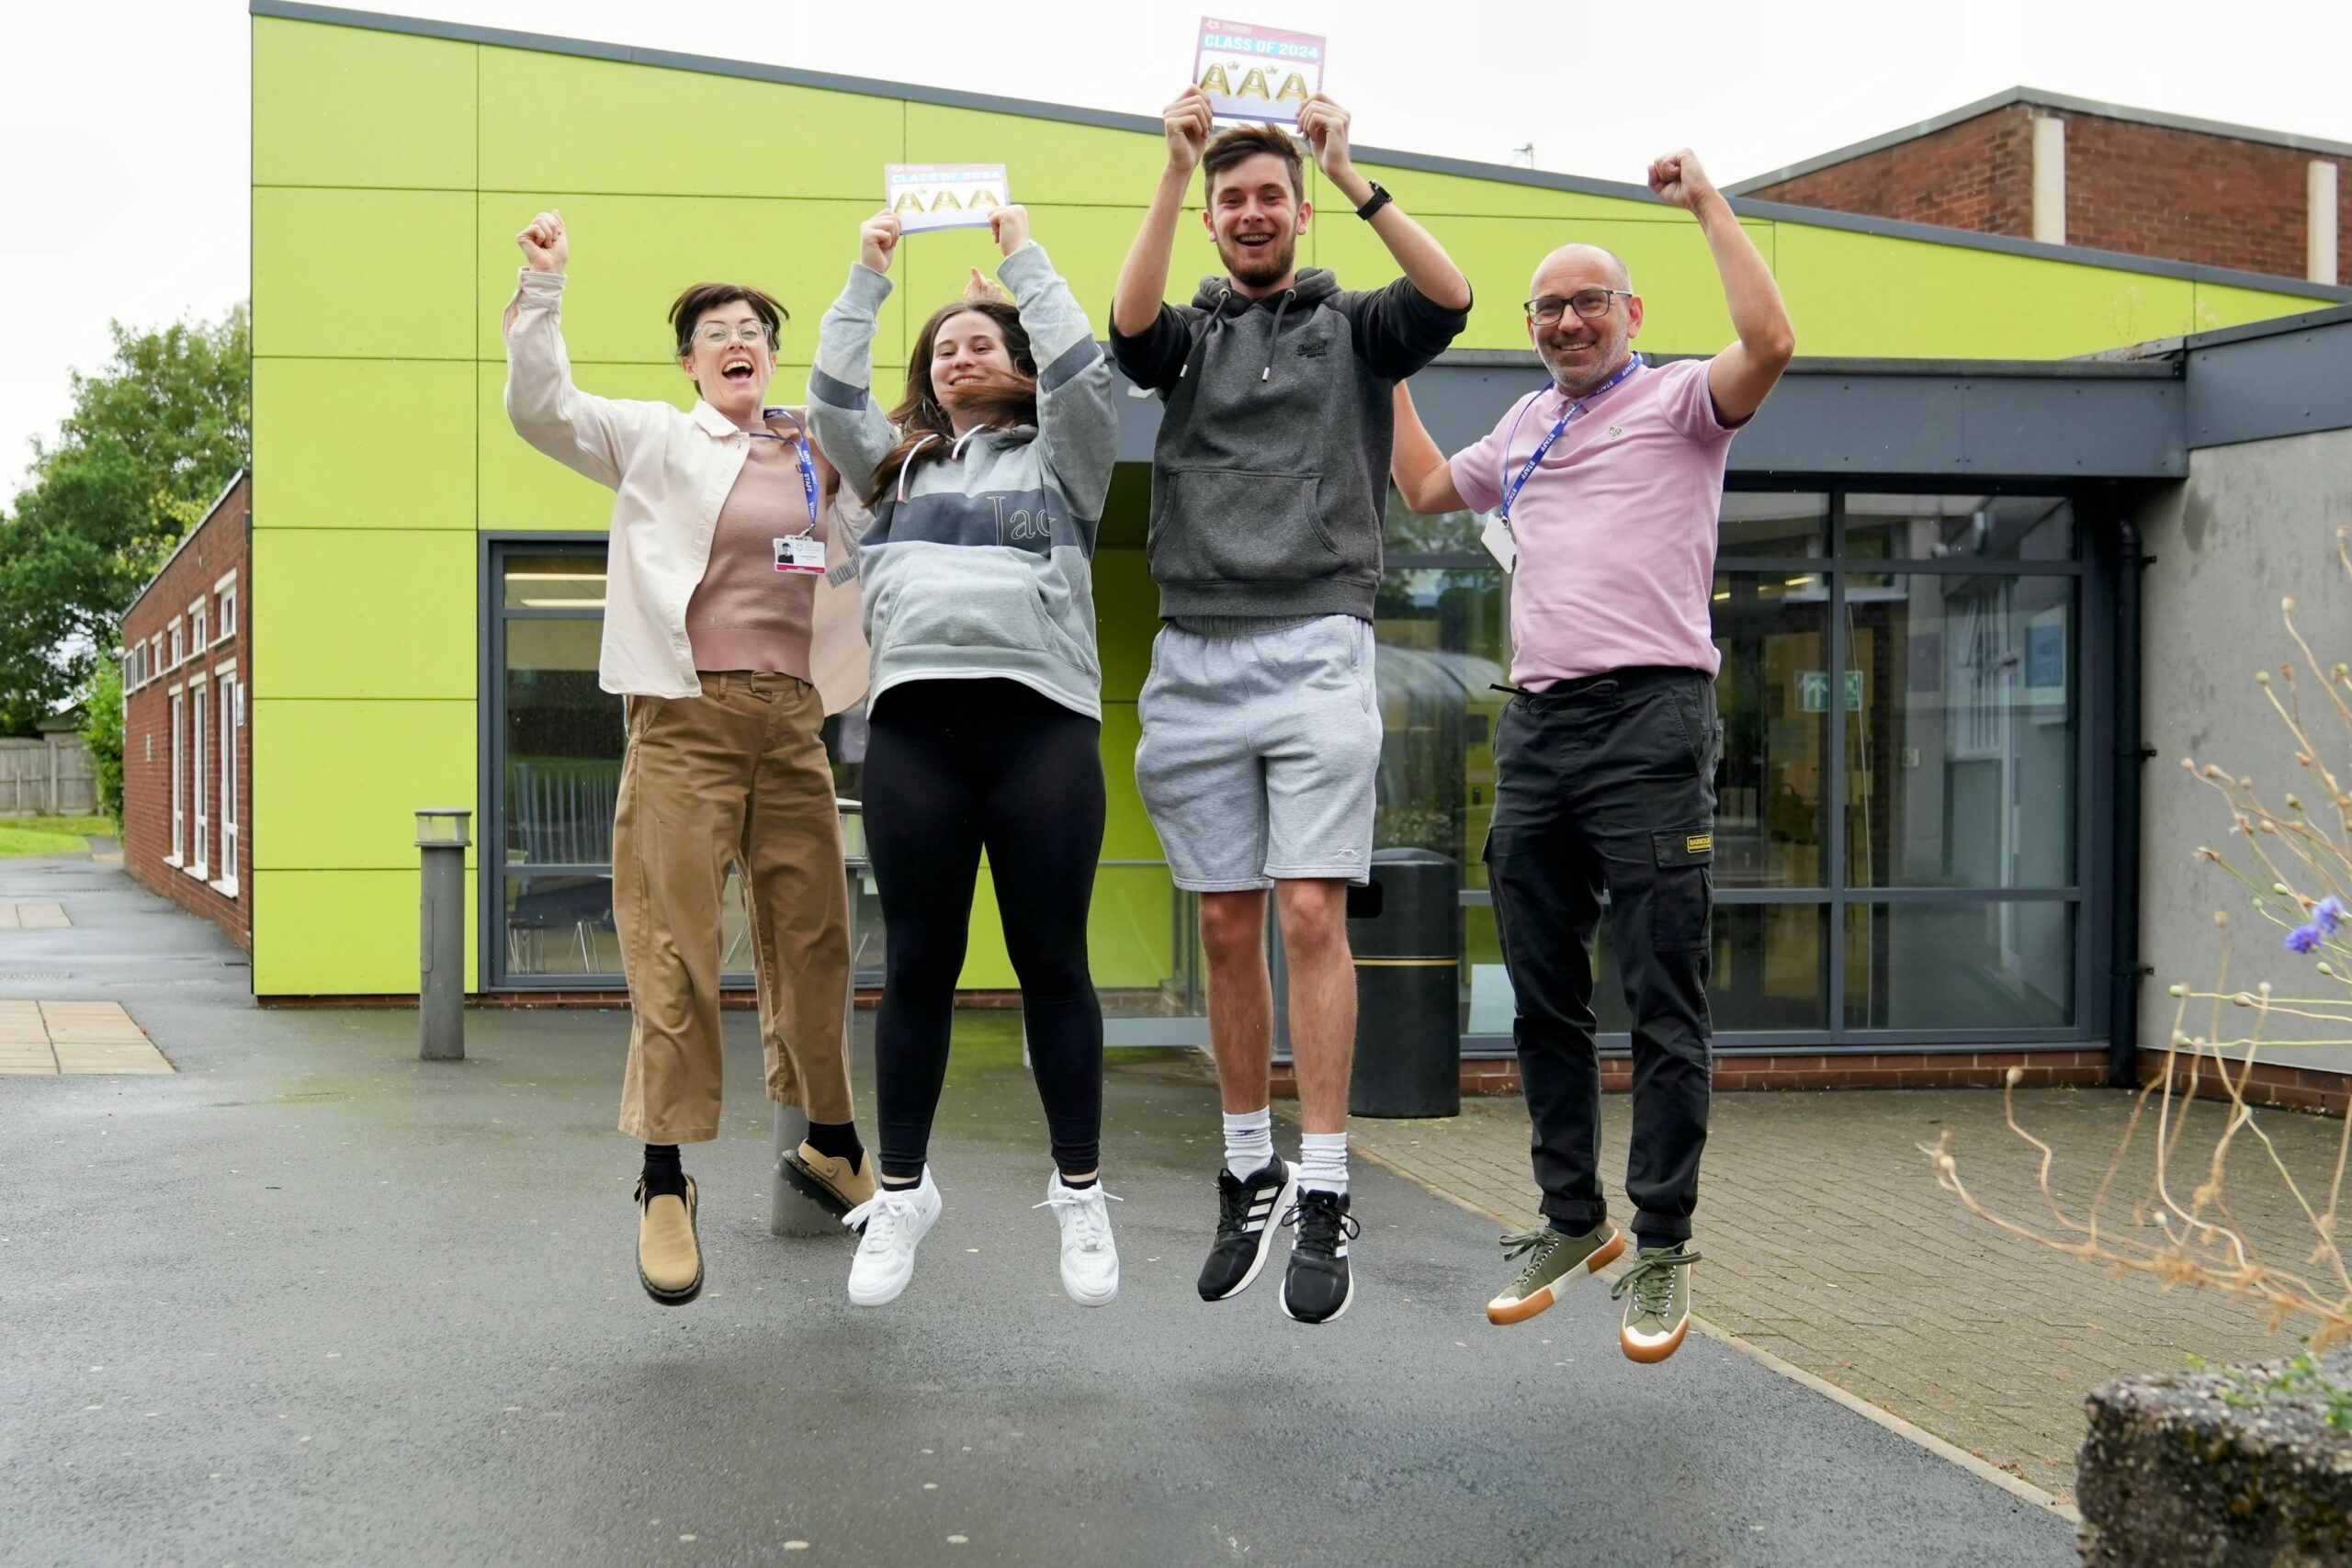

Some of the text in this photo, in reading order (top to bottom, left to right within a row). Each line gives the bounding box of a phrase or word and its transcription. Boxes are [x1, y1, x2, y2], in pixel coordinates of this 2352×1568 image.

[1204, 34, 1318, 59] CLASS OF 2024
[892, 172, 937, 184] CLASS
[941, 172, 956, 182] OF
[1622, 362, 1636, 377] STAFF
[1541, 433, 1555, 452] STAFF
[1521, 460, 1536, 479] STAFF
[803, 473, 813, 492] STAFF
